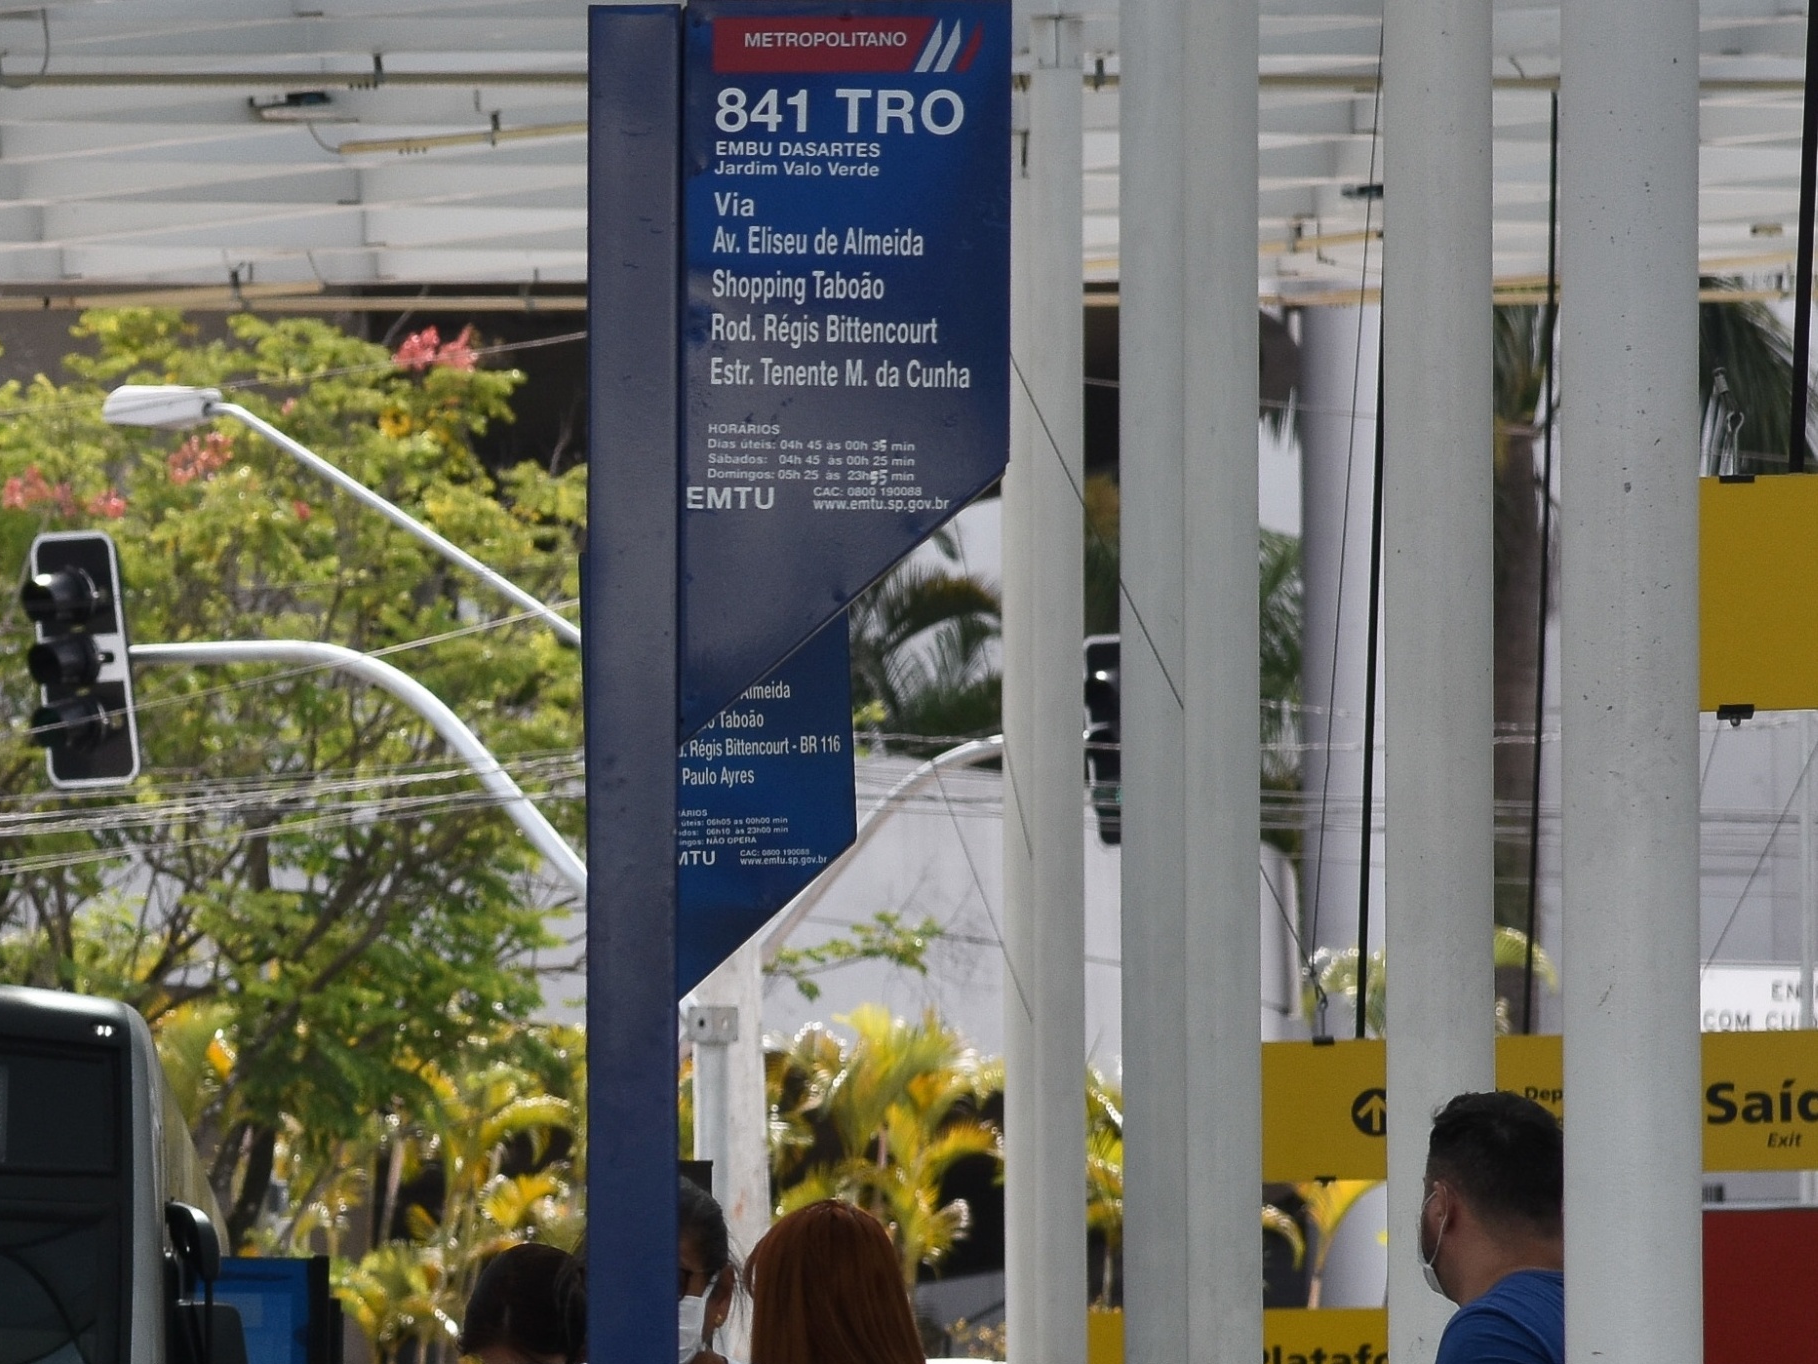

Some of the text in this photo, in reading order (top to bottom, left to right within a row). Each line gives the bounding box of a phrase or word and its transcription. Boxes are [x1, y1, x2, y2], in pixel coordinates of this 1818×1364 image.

[744, 32, 907, 48] METROPOLITANO
[714, 87, 965, 135] 841 TRO
[715, 141, 773, 157] EMBU
[714, 161, 880, 177] Jardim Valo Verde
[714, 192, 755, 217] Via
[712, 226, 924, 257] Av. Eliseu de Almeida
[712, 269, 885, 304] Shopping Taboão
[711, 313, 938, 349] Rod. Régis Bittencourt
[710, 358, 971, 389] Estr. Tenente M. da Cunha
[708, 422, 780, 435] HORÁRIOS
[707, 439, 736, 450] Dias
[740, 439, 776, 451] úteis:
[780, 440, 803, 451] 04h
[806, 440, 822, 452] 45
[845, 441, 868, 452] 00h
[891, 442, 915, 452] min
[708, 453, 767, 465] Sábados:
[778, 454, 802, 465] 04h
[805, 454, 820, 466] 45
[846, 455, 869, 466] 00h
[873, 456, 888, 467] 25
[891, 457, 915, 467] min
[707, 468, 774, 482] Domingos:
[778, 470, 801, 480] 05h
[803, 470, 819, 481] 25
[891, 472, 914, 482] min
[686, 487, 775, 510] EMTU
[813, 487, 923, 497] CAC: 0800 190088
[813, 498, 950, 514] www.emtu.sp.gov.br
[720, 710, 764, 729] Taboão
[689, 738, 723, 761] Régis
[725, 737, 789, 757] Bittencourt
[800, 735, 818, 754] BR
[821, 735, 841, 753] 116
[682, 766, 755, 788] Paulo Ayres
[679, 808, 708, 817] ÁRIOS
[772, 816, 789, 825] min
[1767, 1132, 1803, 1149] Exit
